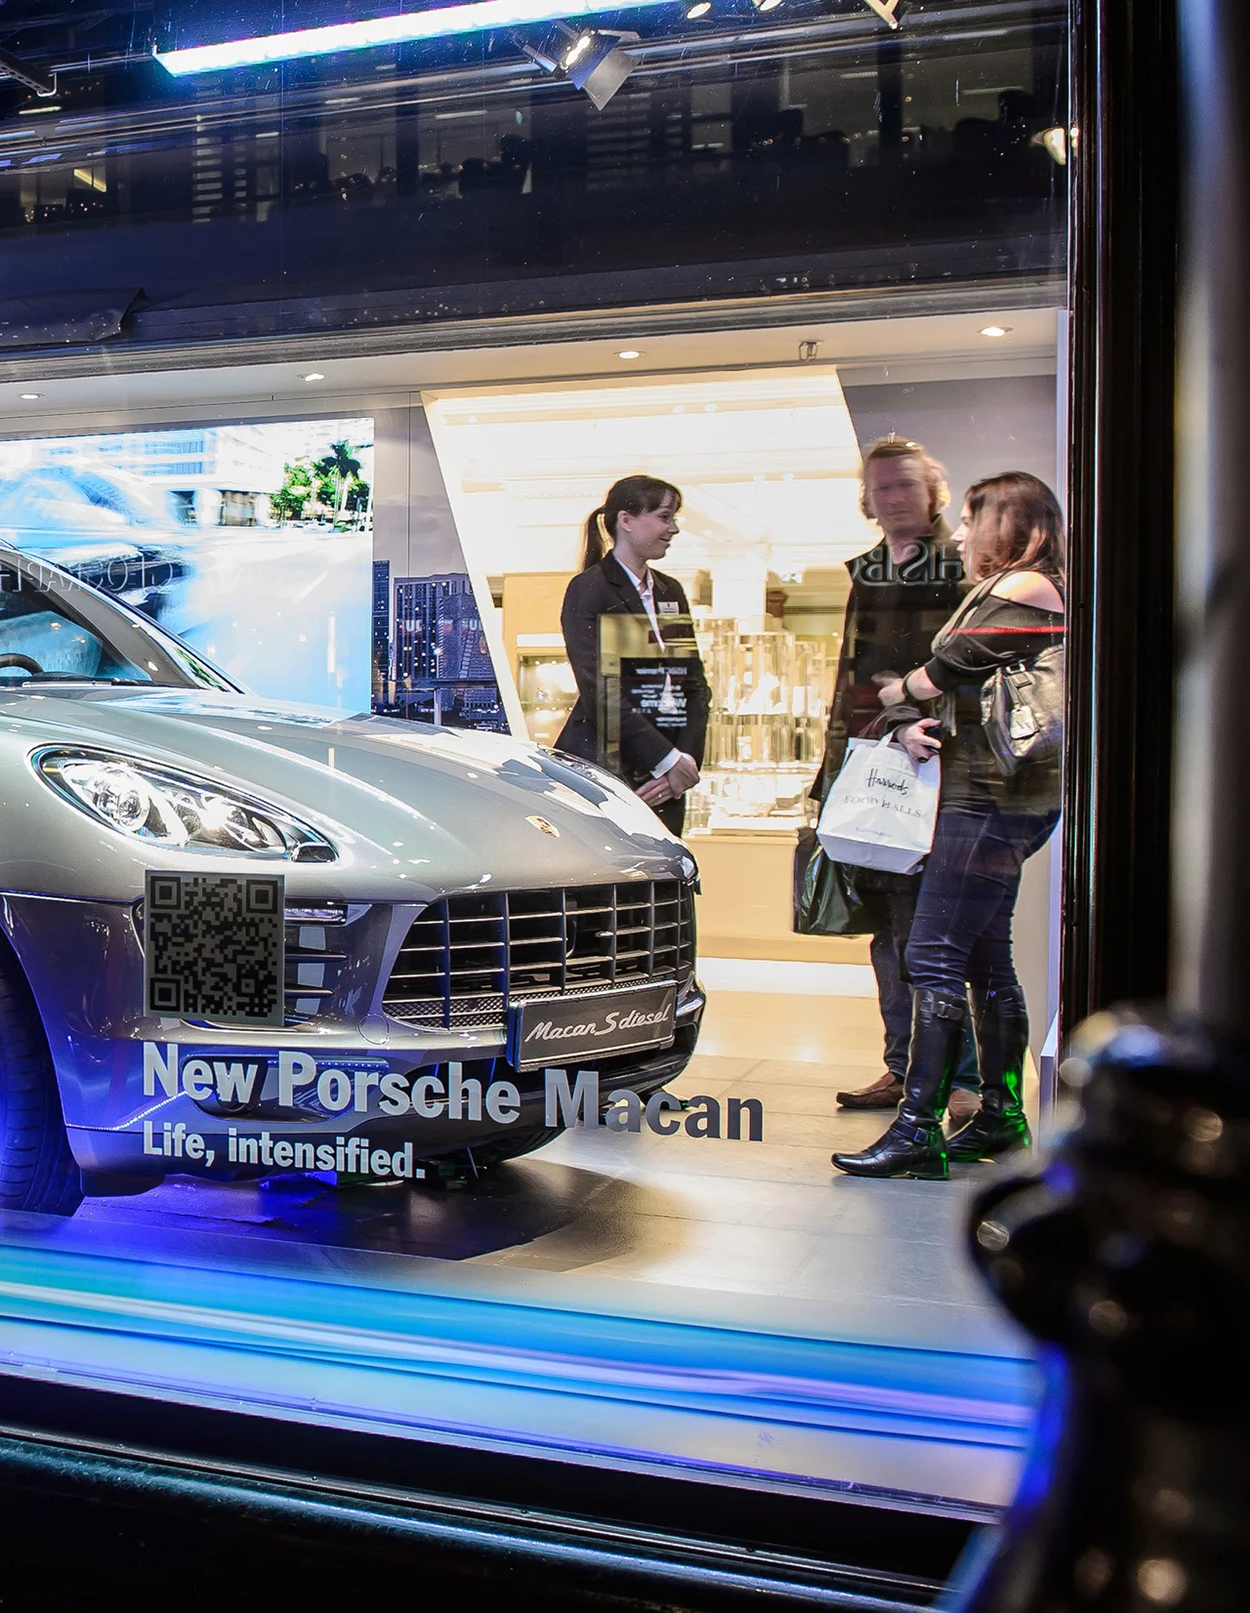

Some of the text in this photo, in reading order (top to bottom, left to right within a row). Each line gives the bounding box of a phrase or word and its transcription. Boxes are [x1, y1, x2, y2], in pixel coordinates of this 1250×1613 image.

[866, 768, 908, 795] Harrods
[525, 1022, 596, 1043] Macan
[143, 1042, 764, 1142] New Porsche Macan
[143, 1121, 426, 1179] Life, intensified.
